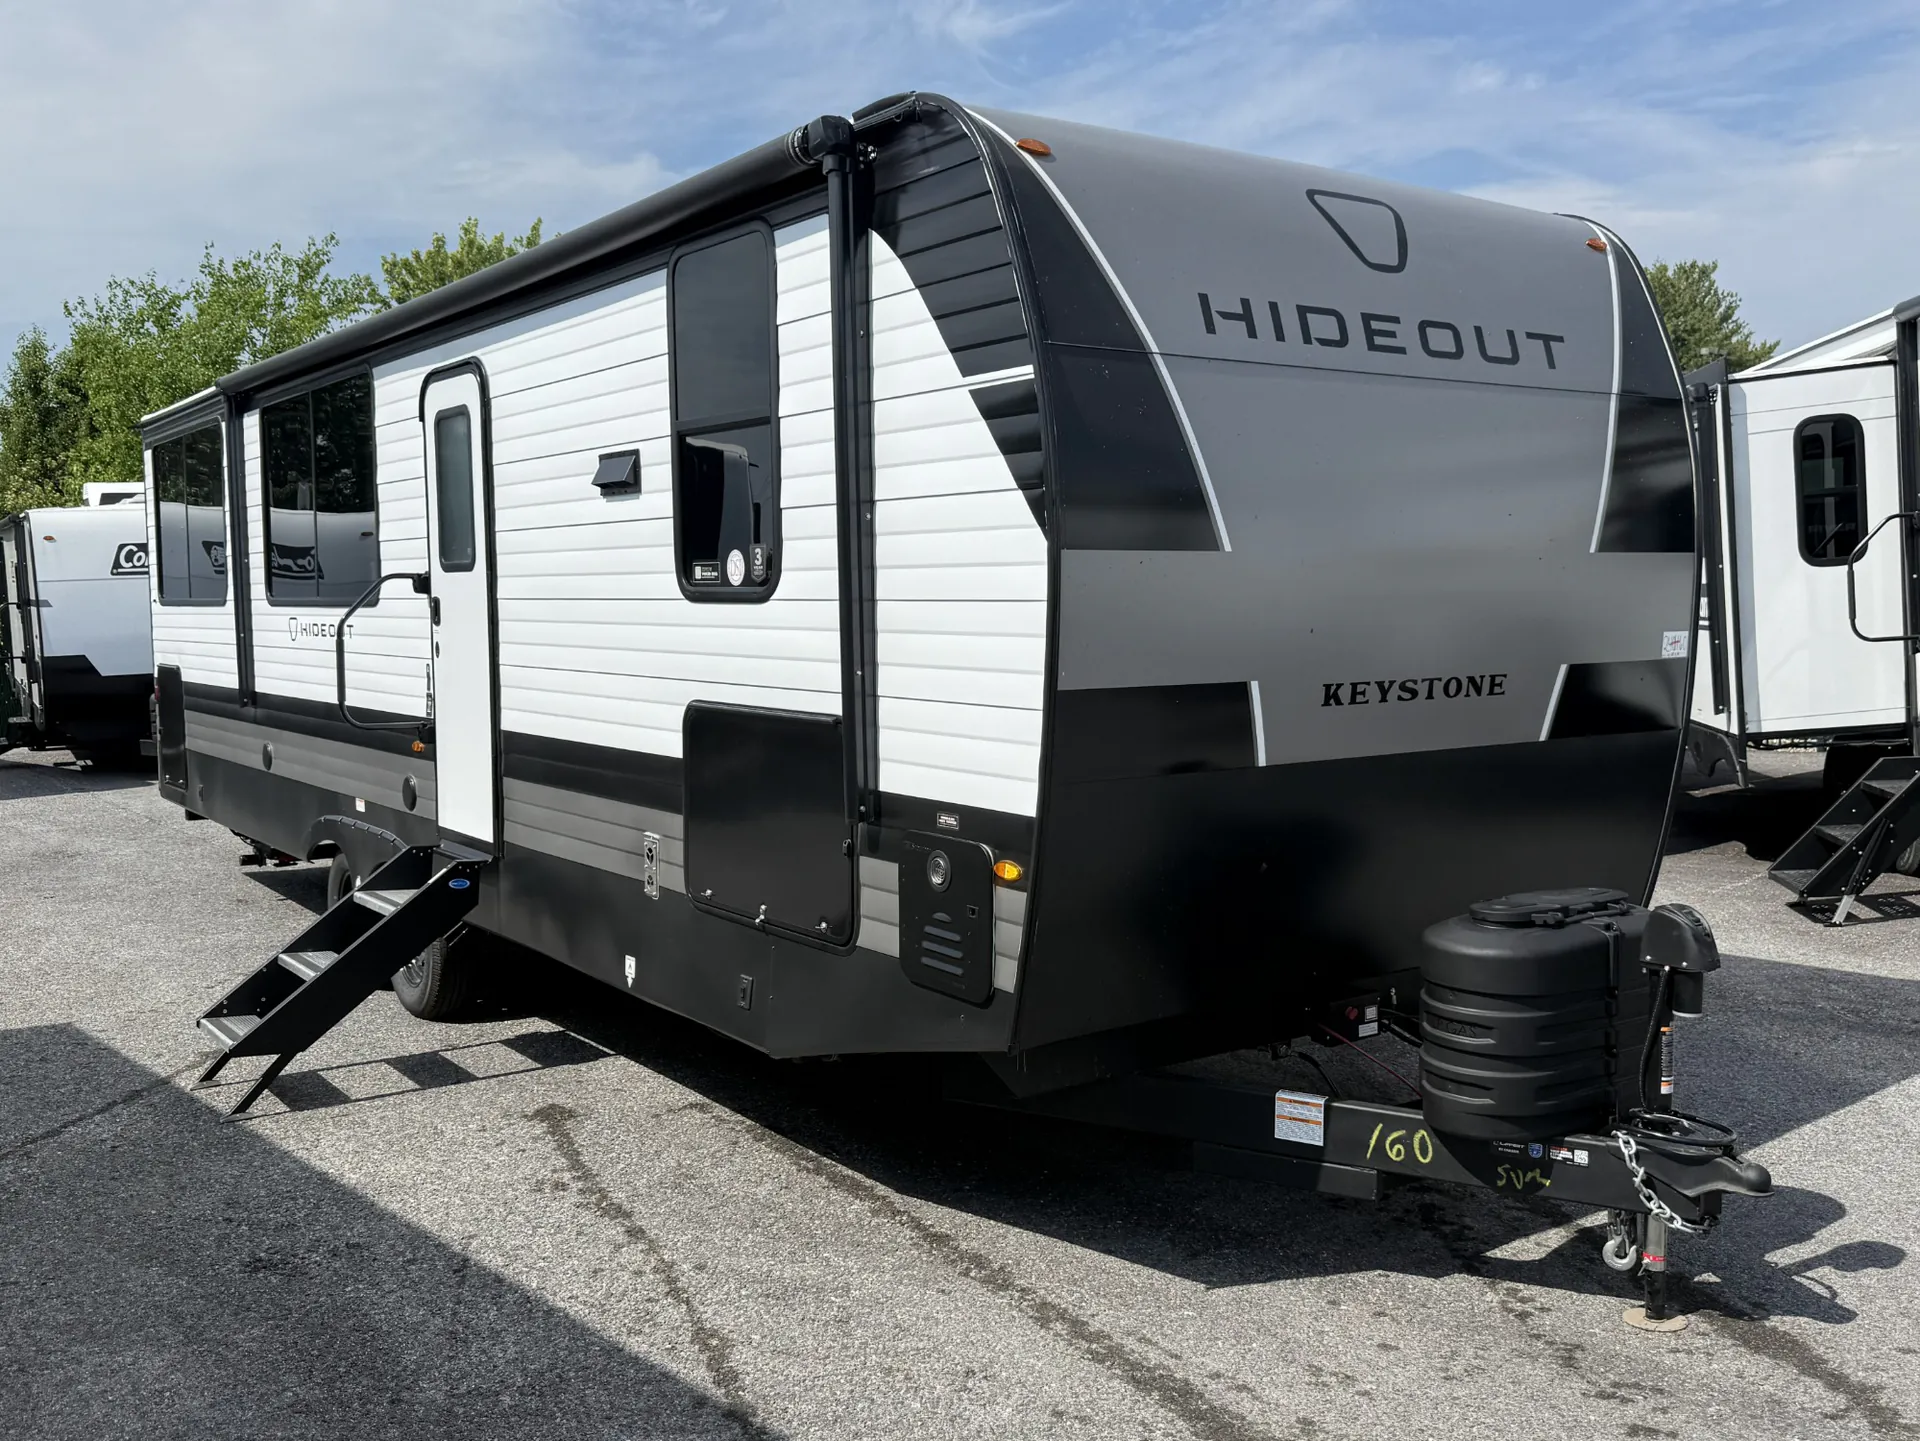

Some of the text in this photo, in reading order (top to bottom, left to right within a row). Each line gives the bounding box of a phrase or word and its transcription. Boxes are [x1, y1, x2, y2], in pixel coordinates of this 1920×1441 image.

[1197, 292, 1565, 370] HIDEOUT
[754, 548, 762, 565] 3
[300, 622, 354, 639] HIDEOT
[1321, 673, 1508, 708] KEYSTONE
[1366, 1122, 1433, 1164] 160
